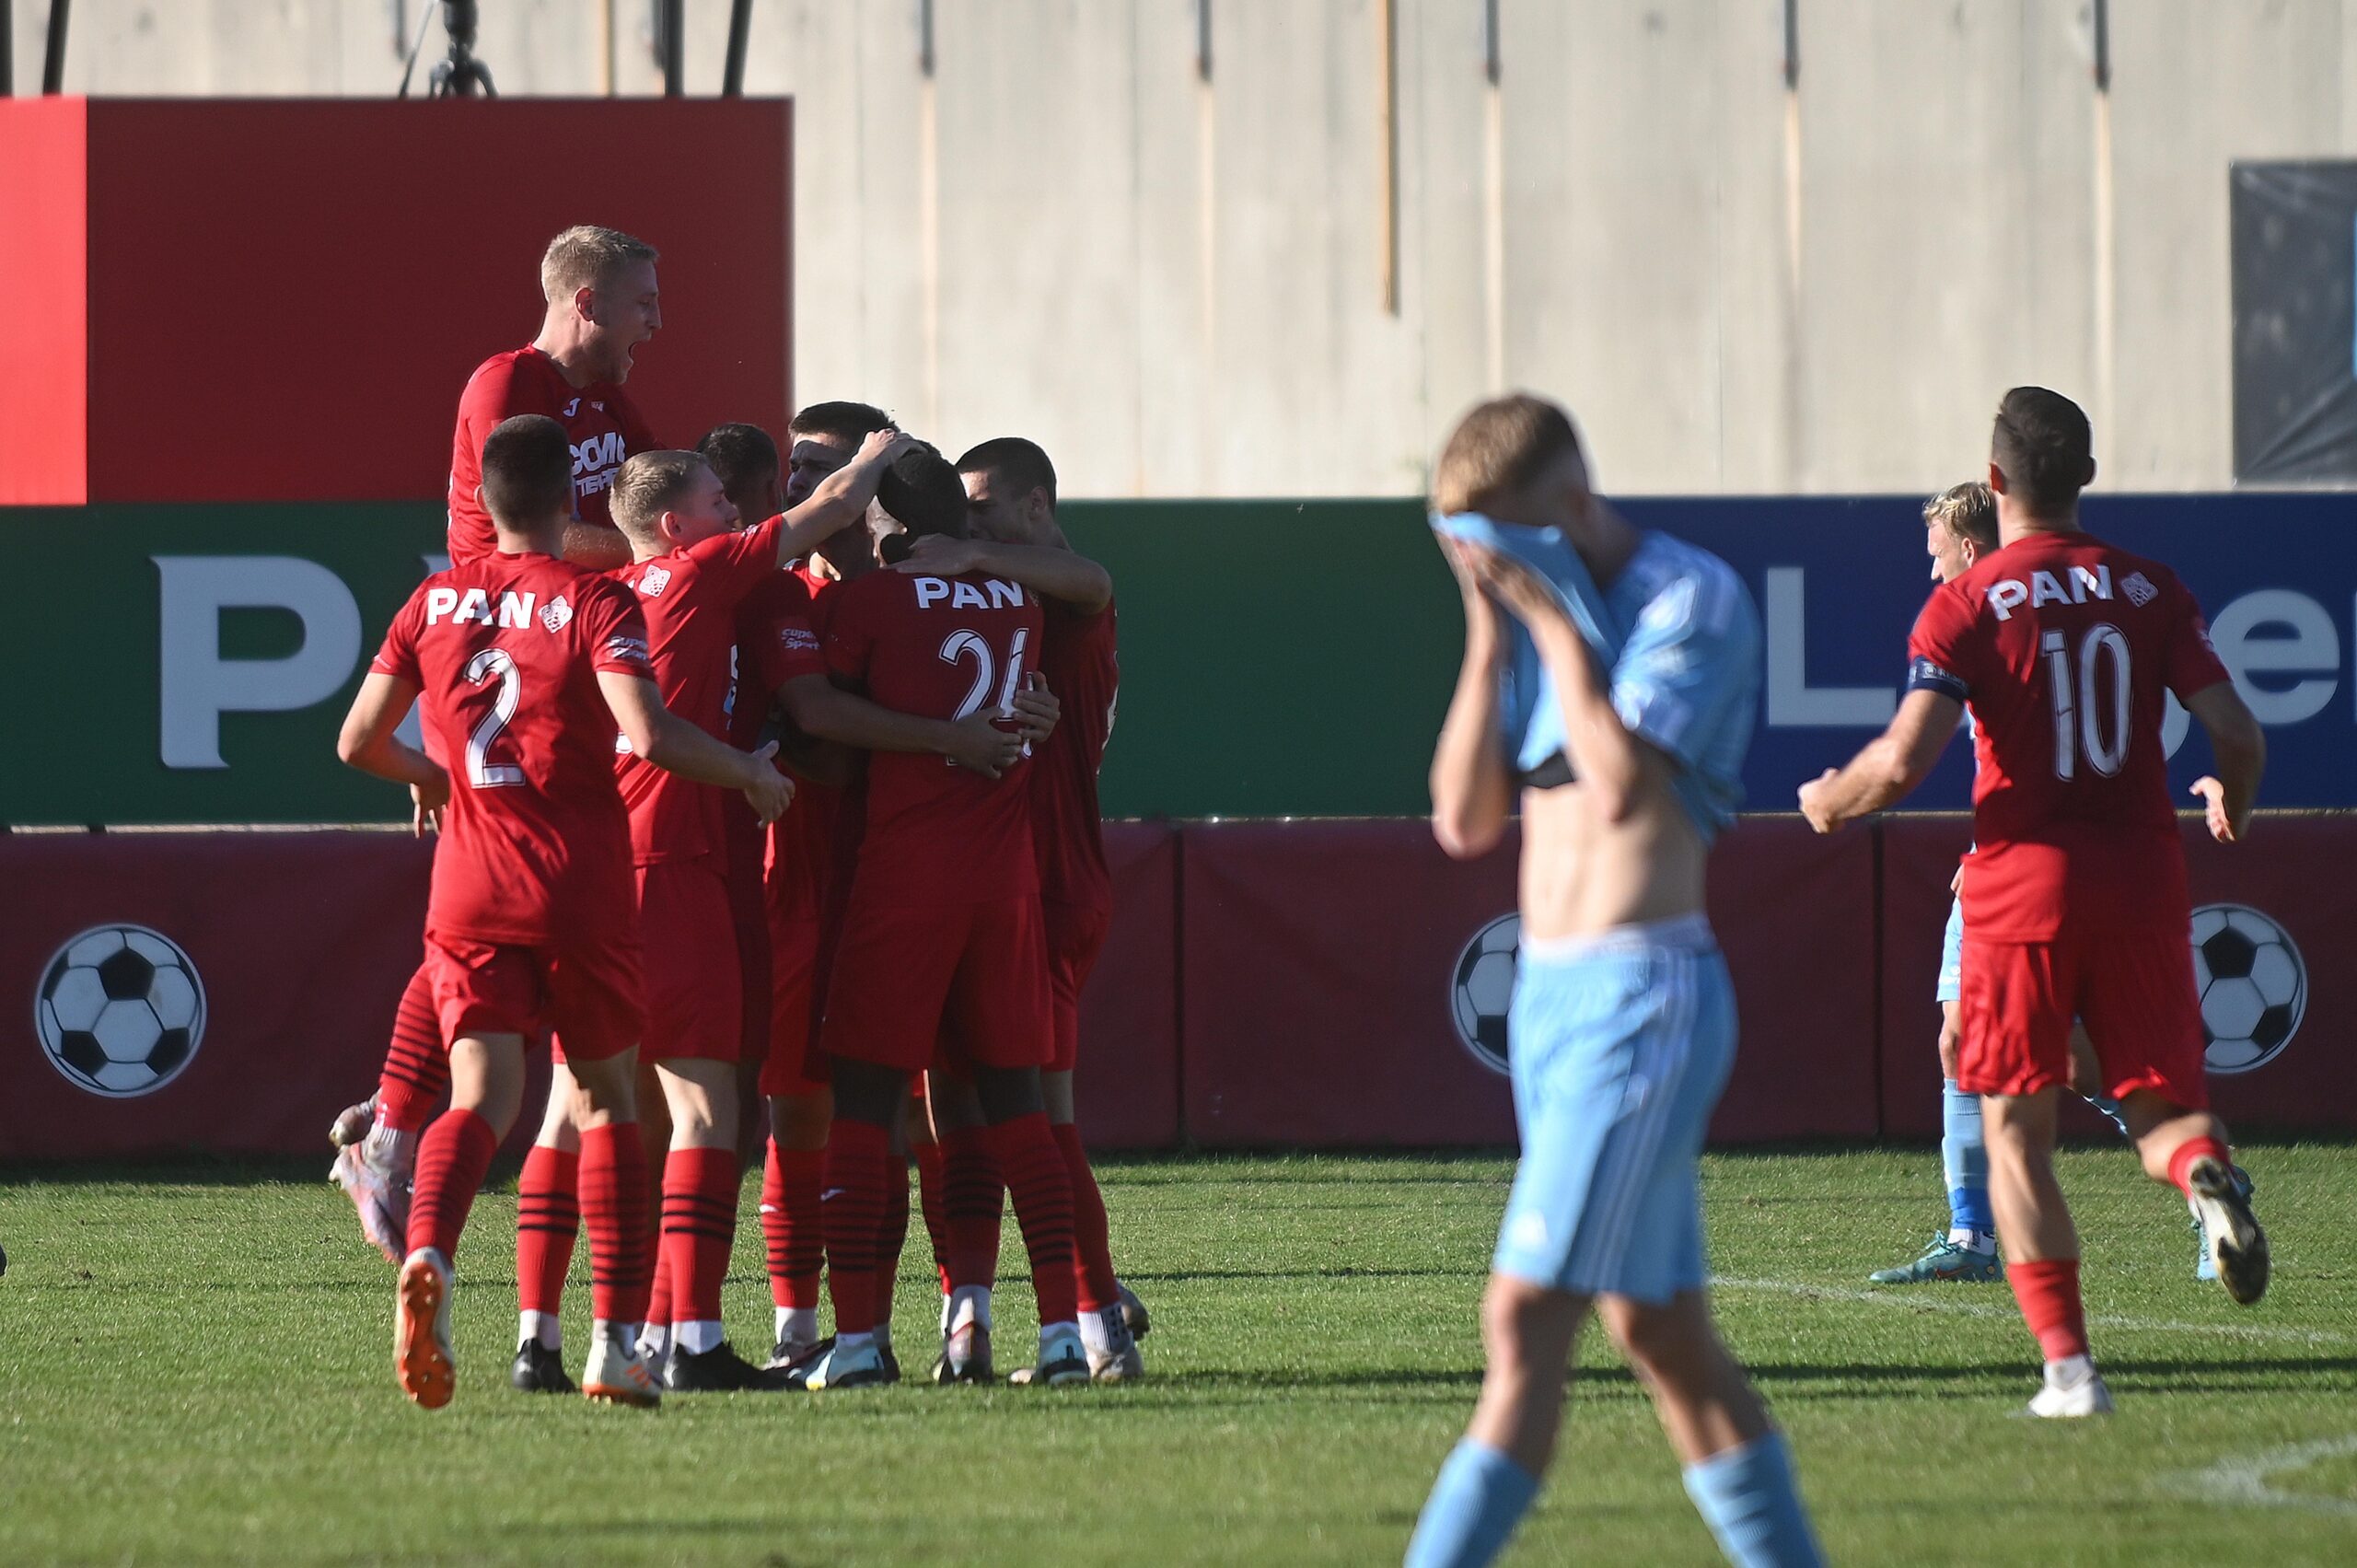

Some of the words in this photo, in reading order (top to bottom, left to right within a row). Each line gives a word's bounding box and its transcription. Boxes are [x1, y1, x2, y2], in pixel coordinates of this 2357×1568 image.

[427, 587, 536, 629] PAN
[914, 576, 1025, 610] PAN
[1984, 563, 2114, 621] PAN
[462, 647, 526, 789] 2
[2041, 621, 2134, 783] 10
